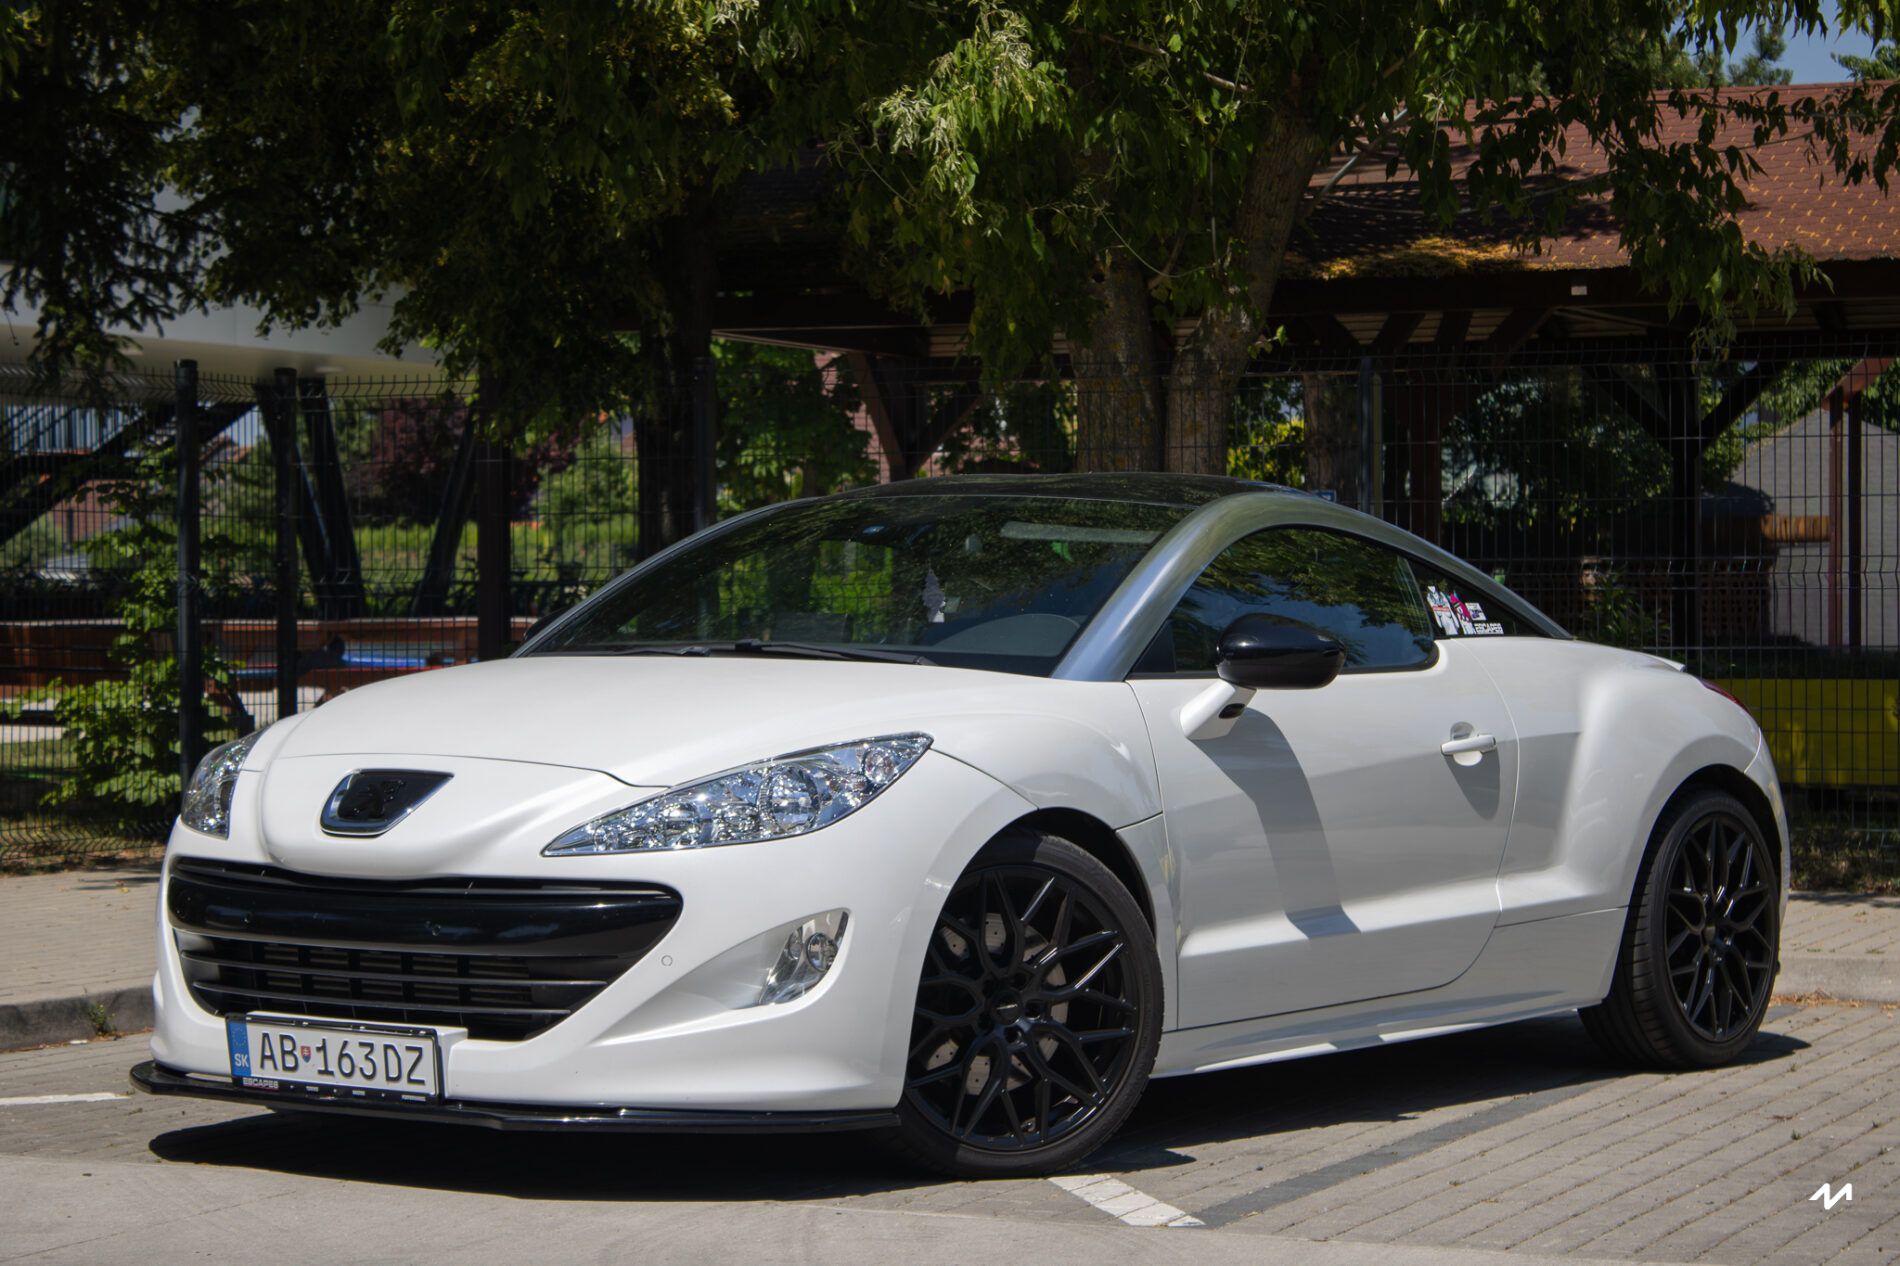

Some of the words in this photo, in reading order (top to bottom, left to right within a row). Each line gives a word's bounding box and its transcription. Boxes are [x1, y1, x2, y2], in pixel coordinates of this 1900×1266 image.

[234, 1053, 249, 1067] SK
[260, 1032, 299, 1072] AB
[315, 1038, 426, 1085] 163DZ
